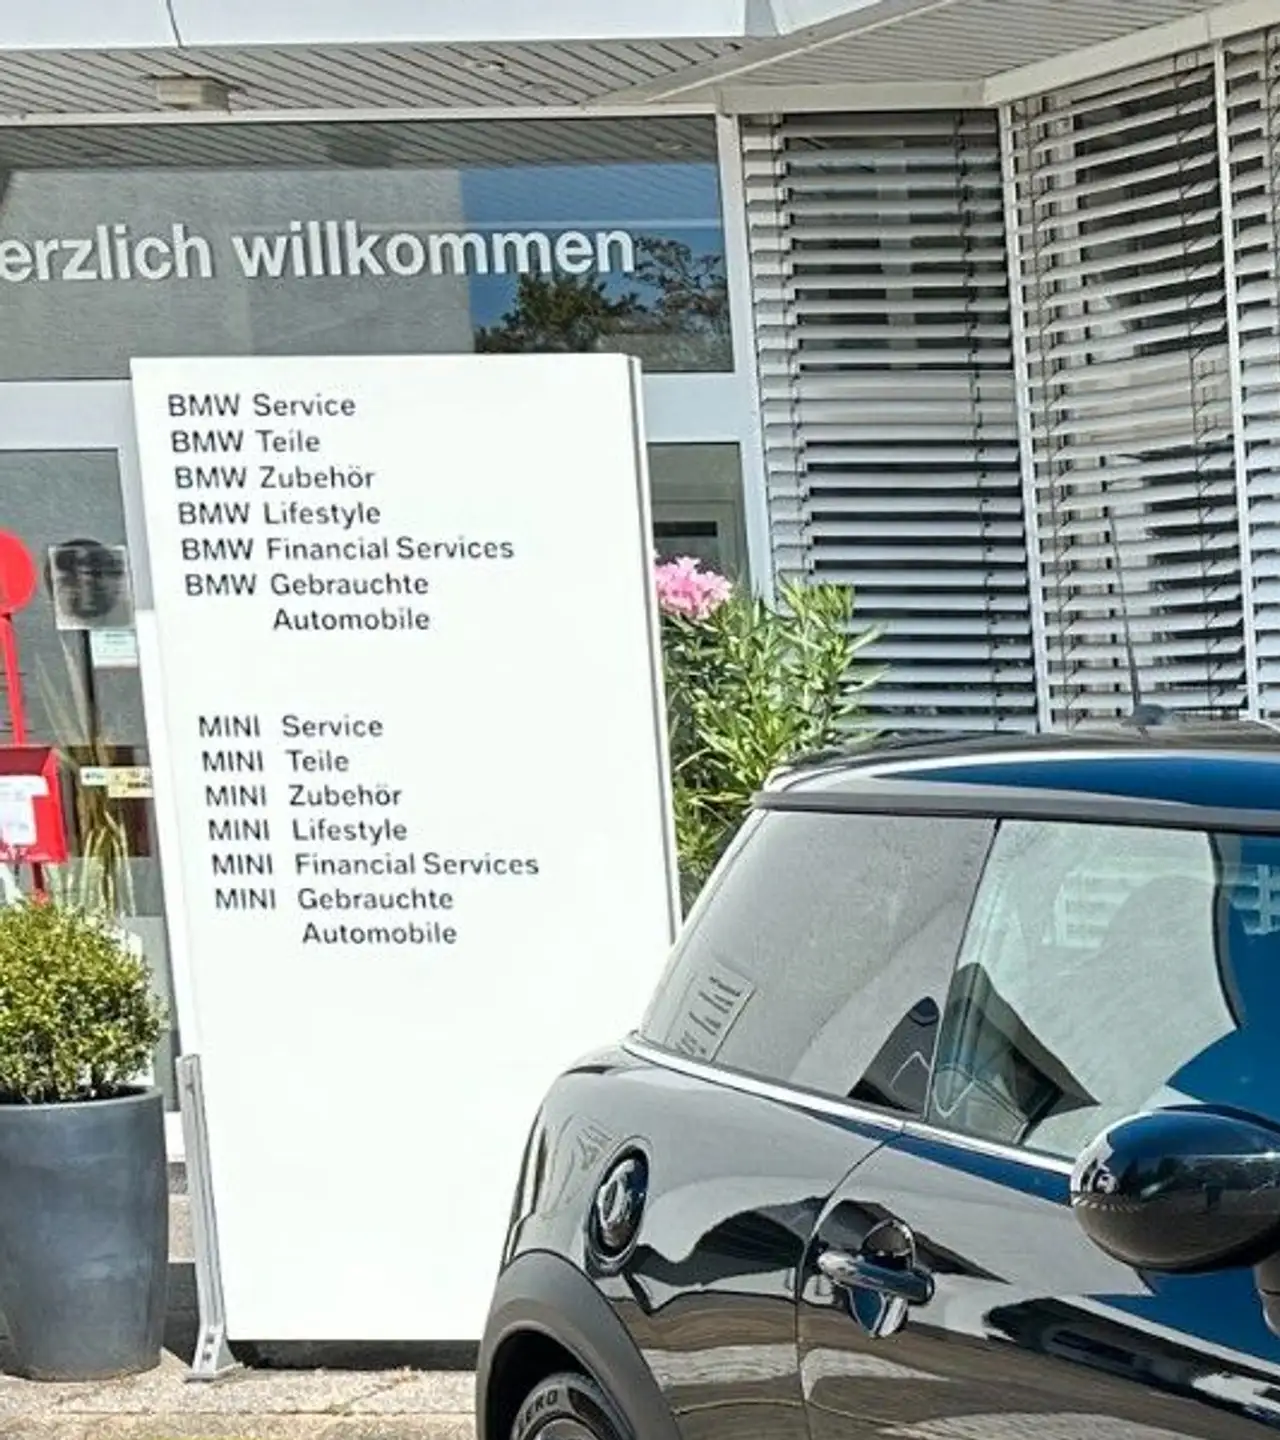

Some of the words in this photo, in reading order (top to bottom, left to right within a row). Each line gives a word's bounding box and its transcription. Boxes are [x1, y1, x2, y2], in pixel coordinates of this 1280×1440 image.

[232, 220, 634, 278] willkommen
[167, 393, 240, 417] BMW
[253, 393, 356, 417] Service
[170, 430, 244, 453] BMW
[255, 429, 320, 453] Teile
[174, 466, 247, 489] BMW
[259, 465, 374, 489] Zubehör
[178, 501, 250, 525] BMW
[263, 501, 381, 530] Lifestyle
[181, 537, 254, 561] BMW
[266, 537, 388, 561] Financial
[396, 535, 514, 560] Services
[184, 573, 257, 597] BMW
[270, 572, 429, 596] Gebrauchte
[273, 608, 430, 631] Automobile
[198, 715, 261, 738] MINI
[282, 714, 383, 738] Service
[201, 750, 264, 772] MINI
[286, 749, 349, 772] Teile
[205, 785, 266, 807] MINI
[288, 784, 401, 807] Zubehör
[208, 819, 270, 841] MINI
[292, 818, 407, 846] Lifestyle
[211, 853, 273, 875] MINI
[295, 853, 416, 875] Financial
[422, 852, 539, 875] Services
[215, 887, 276, 910] MINI
[297, 887, 453, 910] Gebrauchte
[302, 922, 457, 945] Automobile
